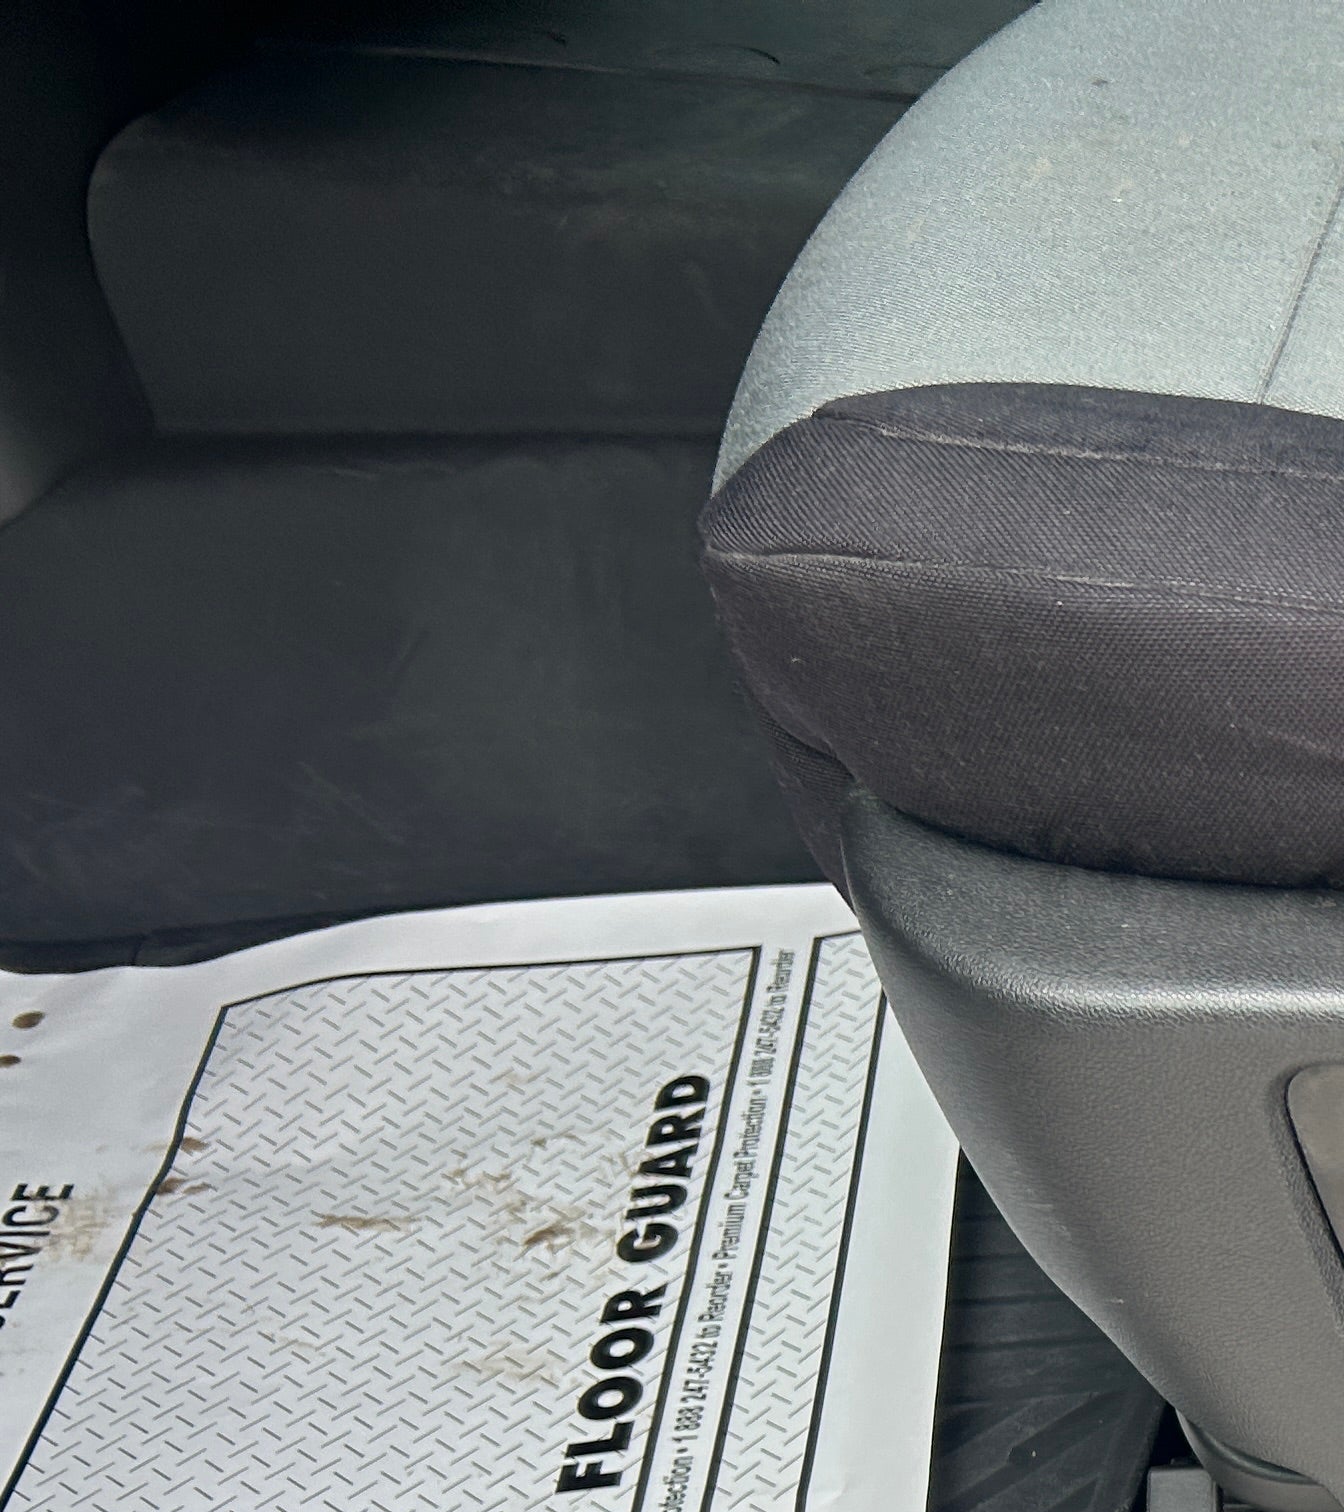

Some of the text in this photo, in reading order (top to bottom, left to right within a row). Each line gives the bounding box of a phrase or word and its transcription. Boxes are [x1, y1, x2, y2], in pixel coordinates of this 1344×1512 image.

[733, 1096, 767, 1160] Protection
[723, 1160, 759, 1200] Carpet
[0, 1183, 75, 1329] RVICE
[712, 1202, 746, 1260] Premium
[555, 1075, 711, 1493] FLOOR GUARD
[698, 1270, 733, 1322] Reorder
[696, 1323, 721, 1339] to
[672, 1434, 698, 1442] 1
[674, 1405, 704, 1432] 888
